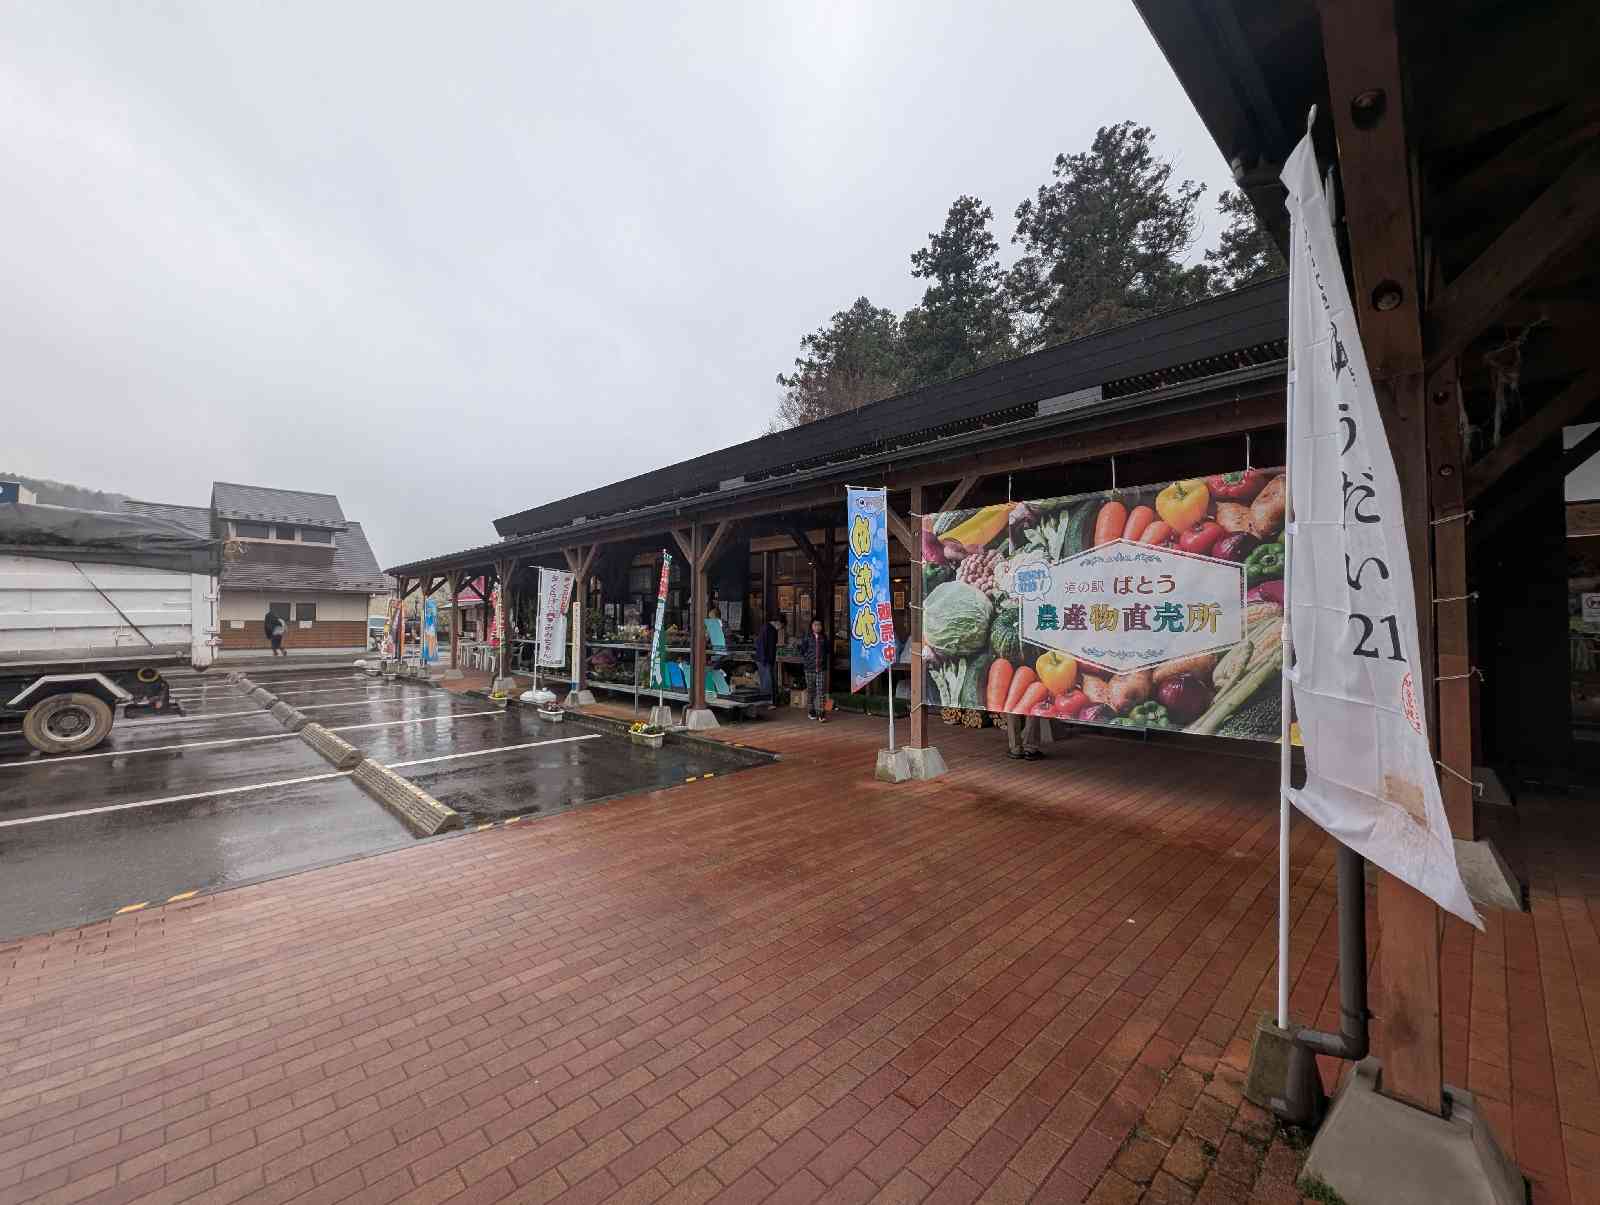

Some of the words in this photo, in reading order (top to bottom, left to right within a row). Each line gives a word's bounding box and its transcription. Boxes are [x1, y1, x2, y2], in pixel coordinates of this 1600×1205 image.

[1113, 574, 1176, 595] ばとう
[1035, 600, 1225, 634] 農産物直売所
